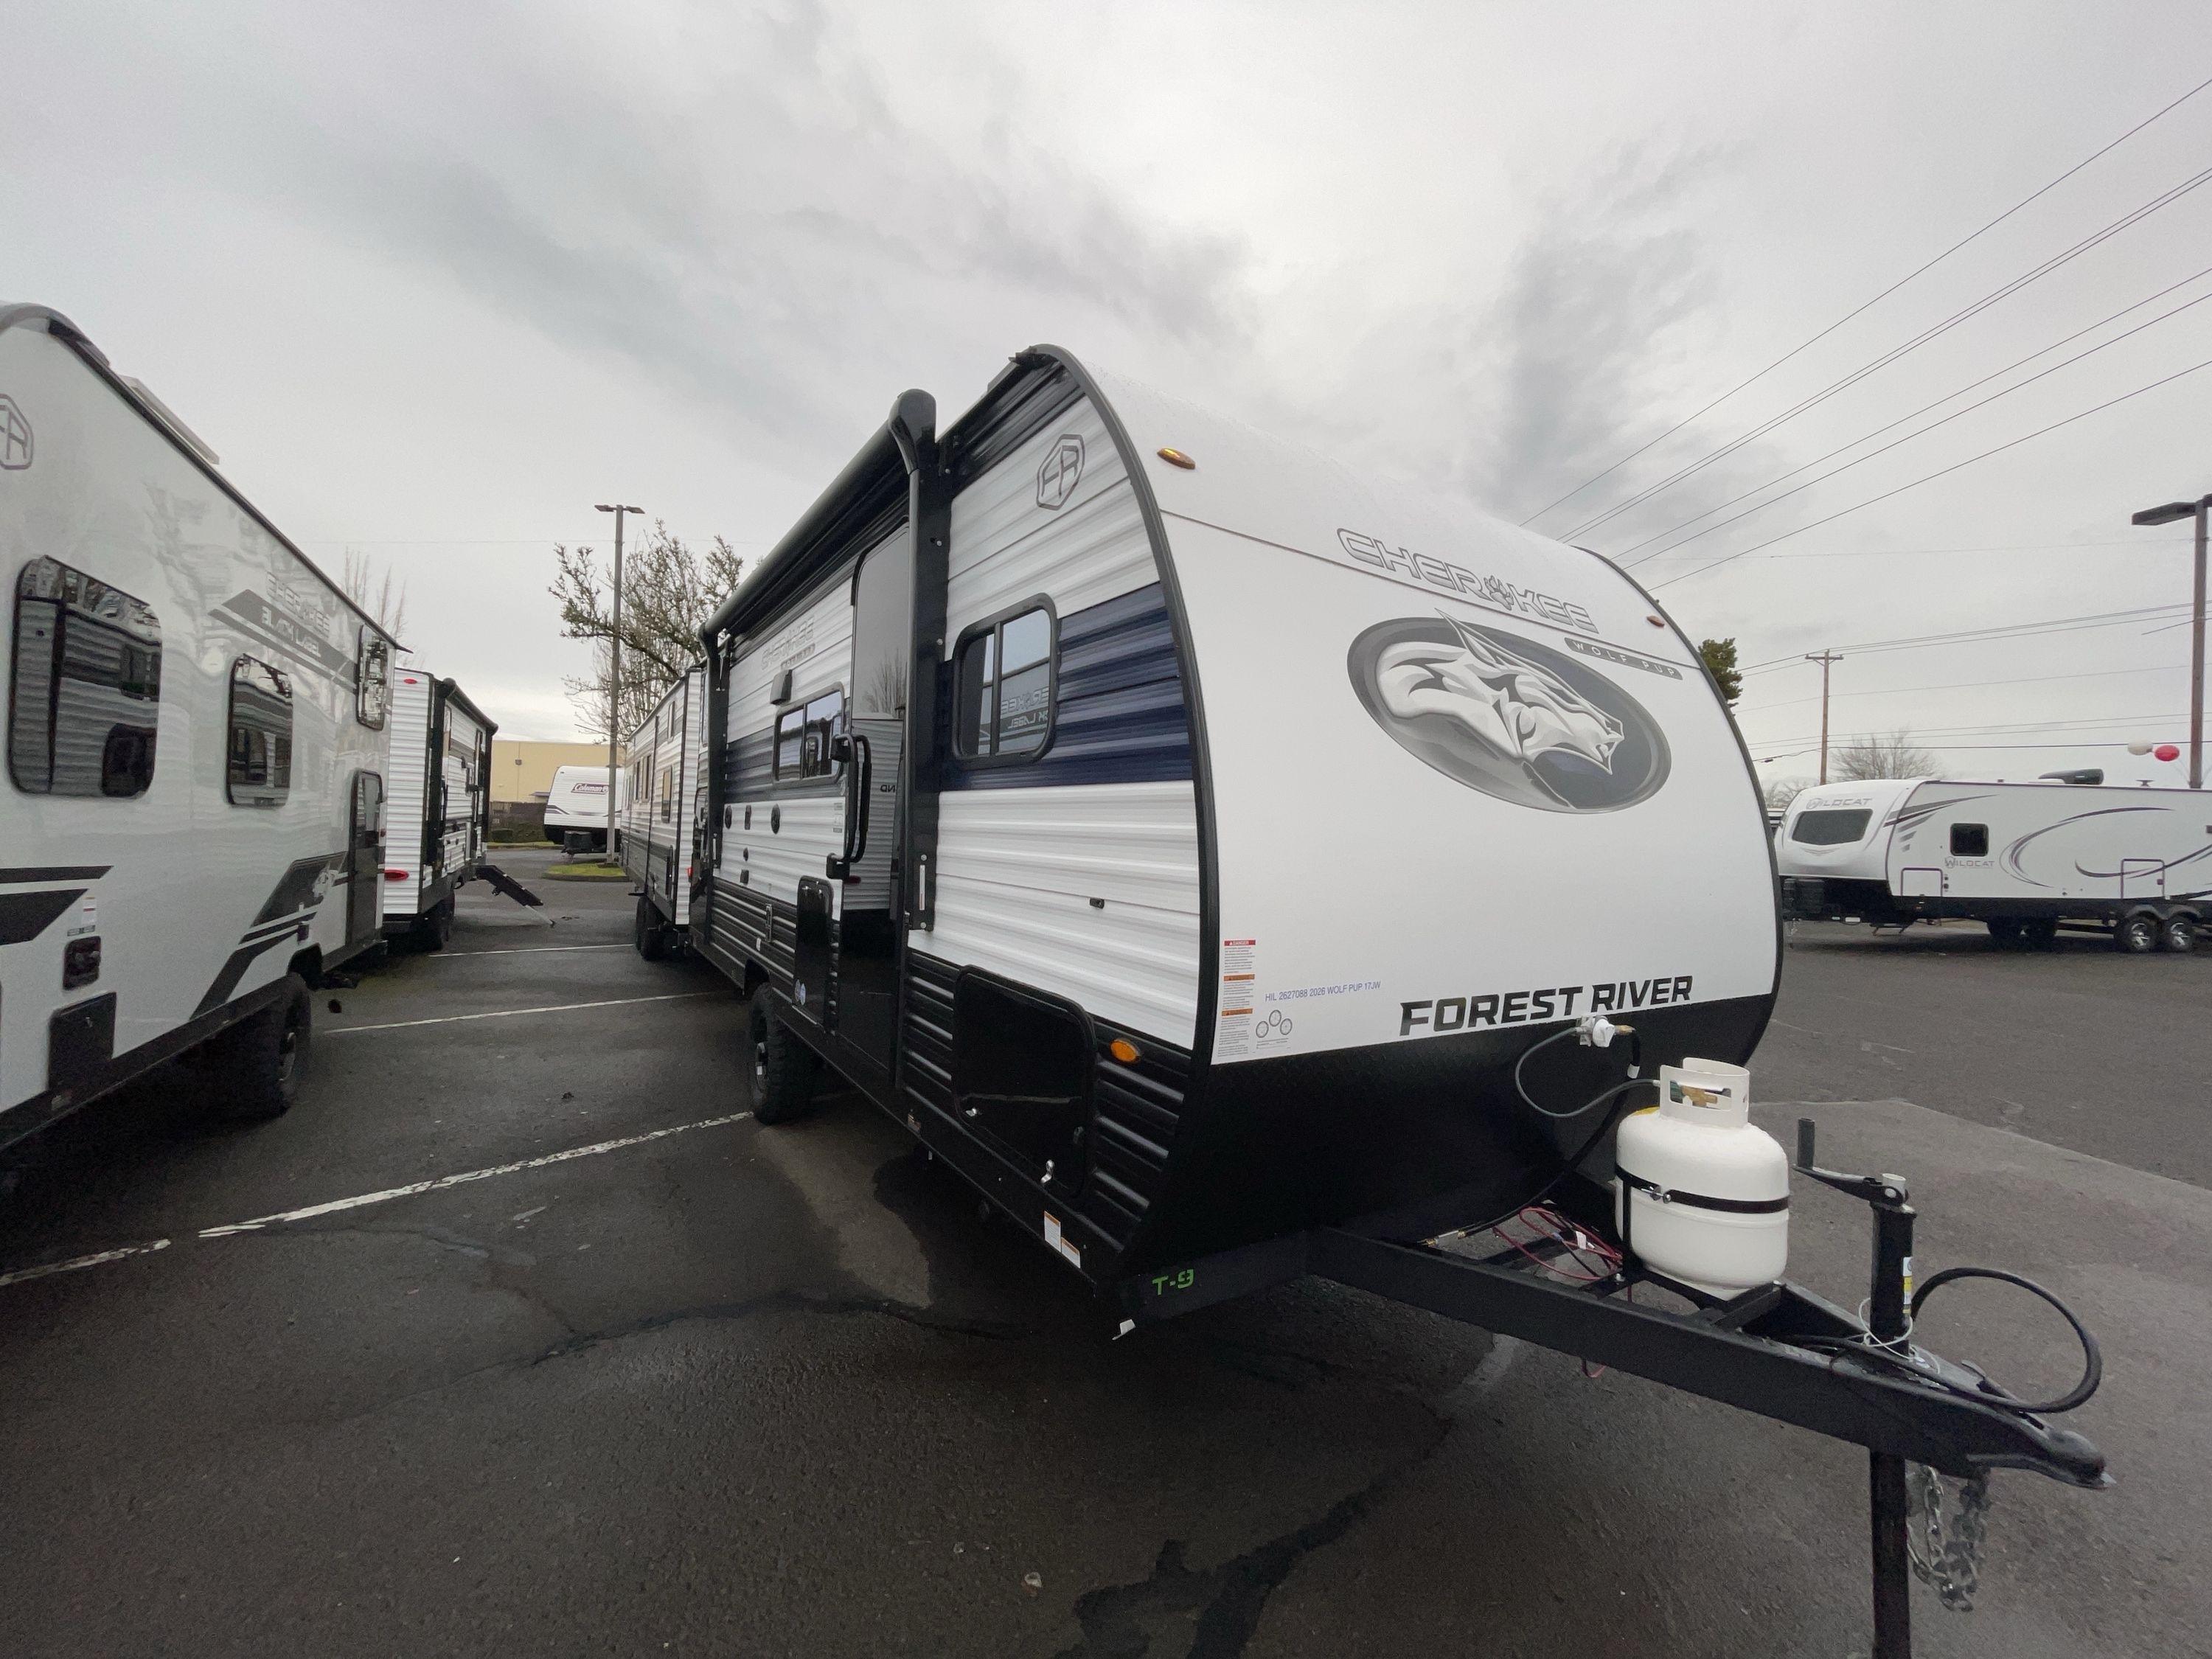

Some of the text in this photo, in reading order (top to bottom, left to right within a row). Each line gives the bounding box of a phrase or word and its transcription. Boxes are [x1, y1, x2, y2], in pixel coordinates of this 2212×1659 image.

[1573, 640, 1675, 676] WOLF PUP
[1944, 856, 1995, 869] WILDCAT
[1265, 981, 1381, 1002] HIL 2627088 2026 WOLF PUP 17JW
[1399, 975, 1694, 1037] FOREST RIVER
